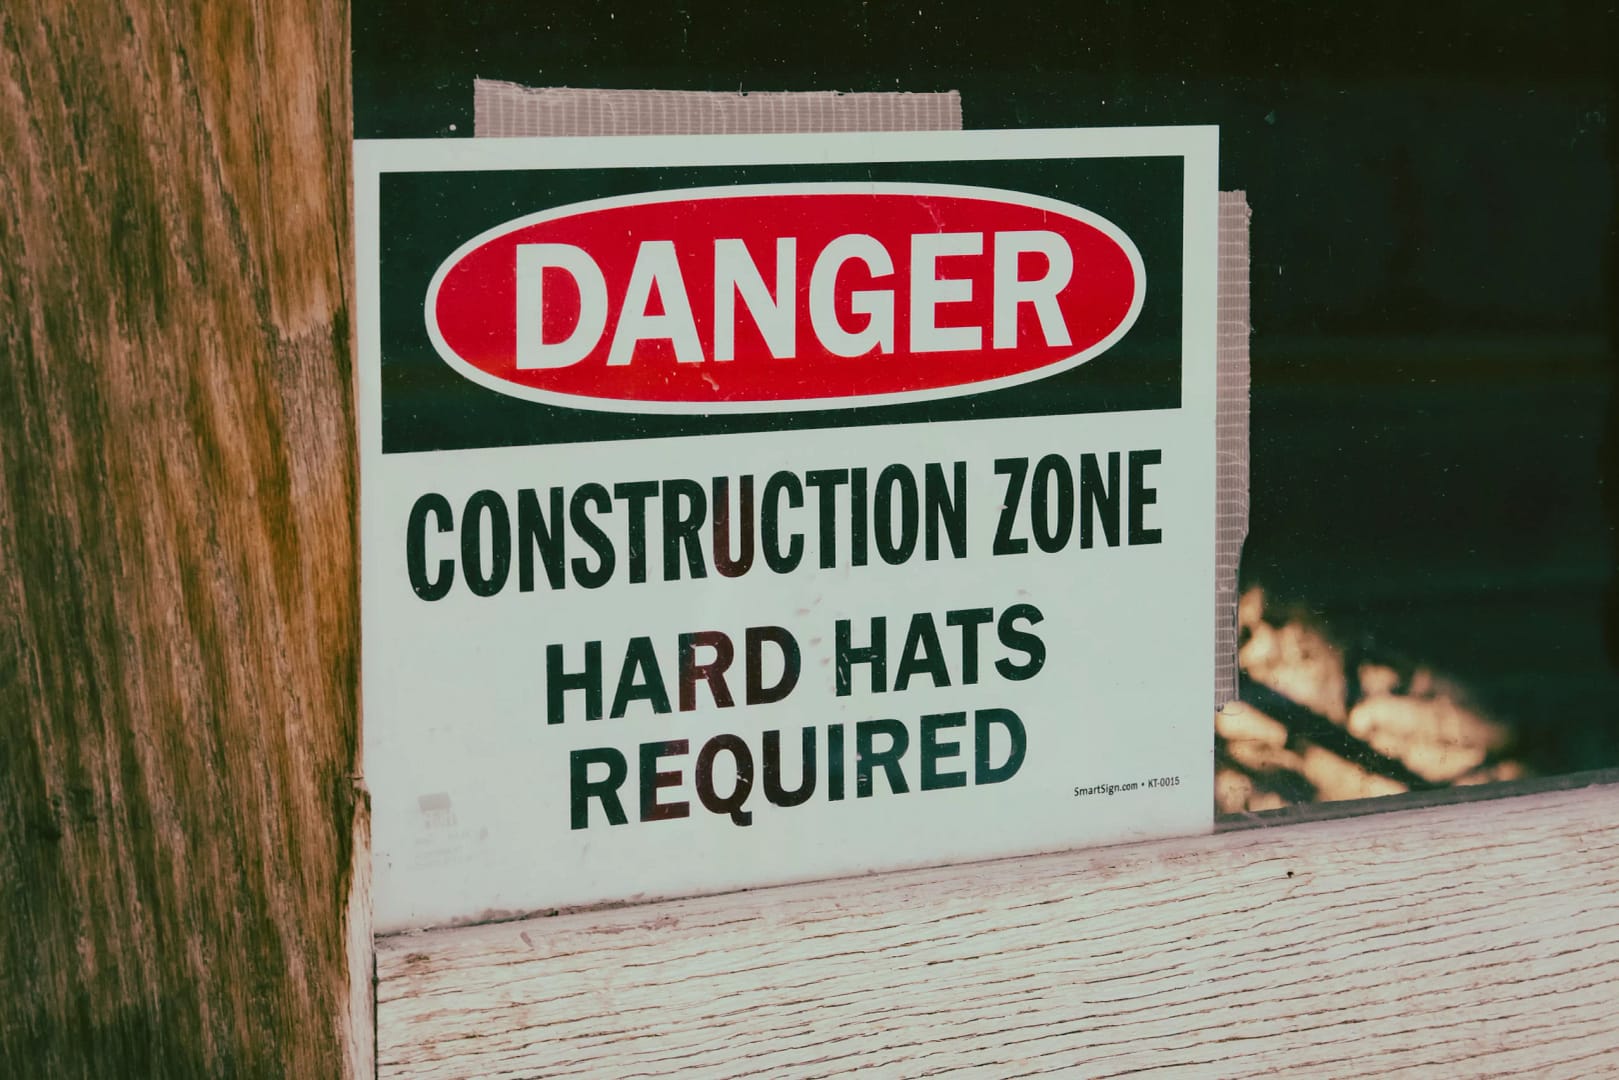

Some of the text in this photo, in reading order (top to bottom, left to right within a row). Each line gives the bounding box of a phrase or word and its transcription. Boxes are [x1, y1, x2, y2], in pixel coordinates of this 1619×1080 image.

[514, 229, 1075, 371] DANGER
[406, 449, 1163, 602] CONSTRUCTION ZONE
[546, 603, 1047, 725] HARD HATS
[570, 707, 1028, 830] REQUIRED
[1073, 775, 1181, 797] SmartSign.com KT-0015
